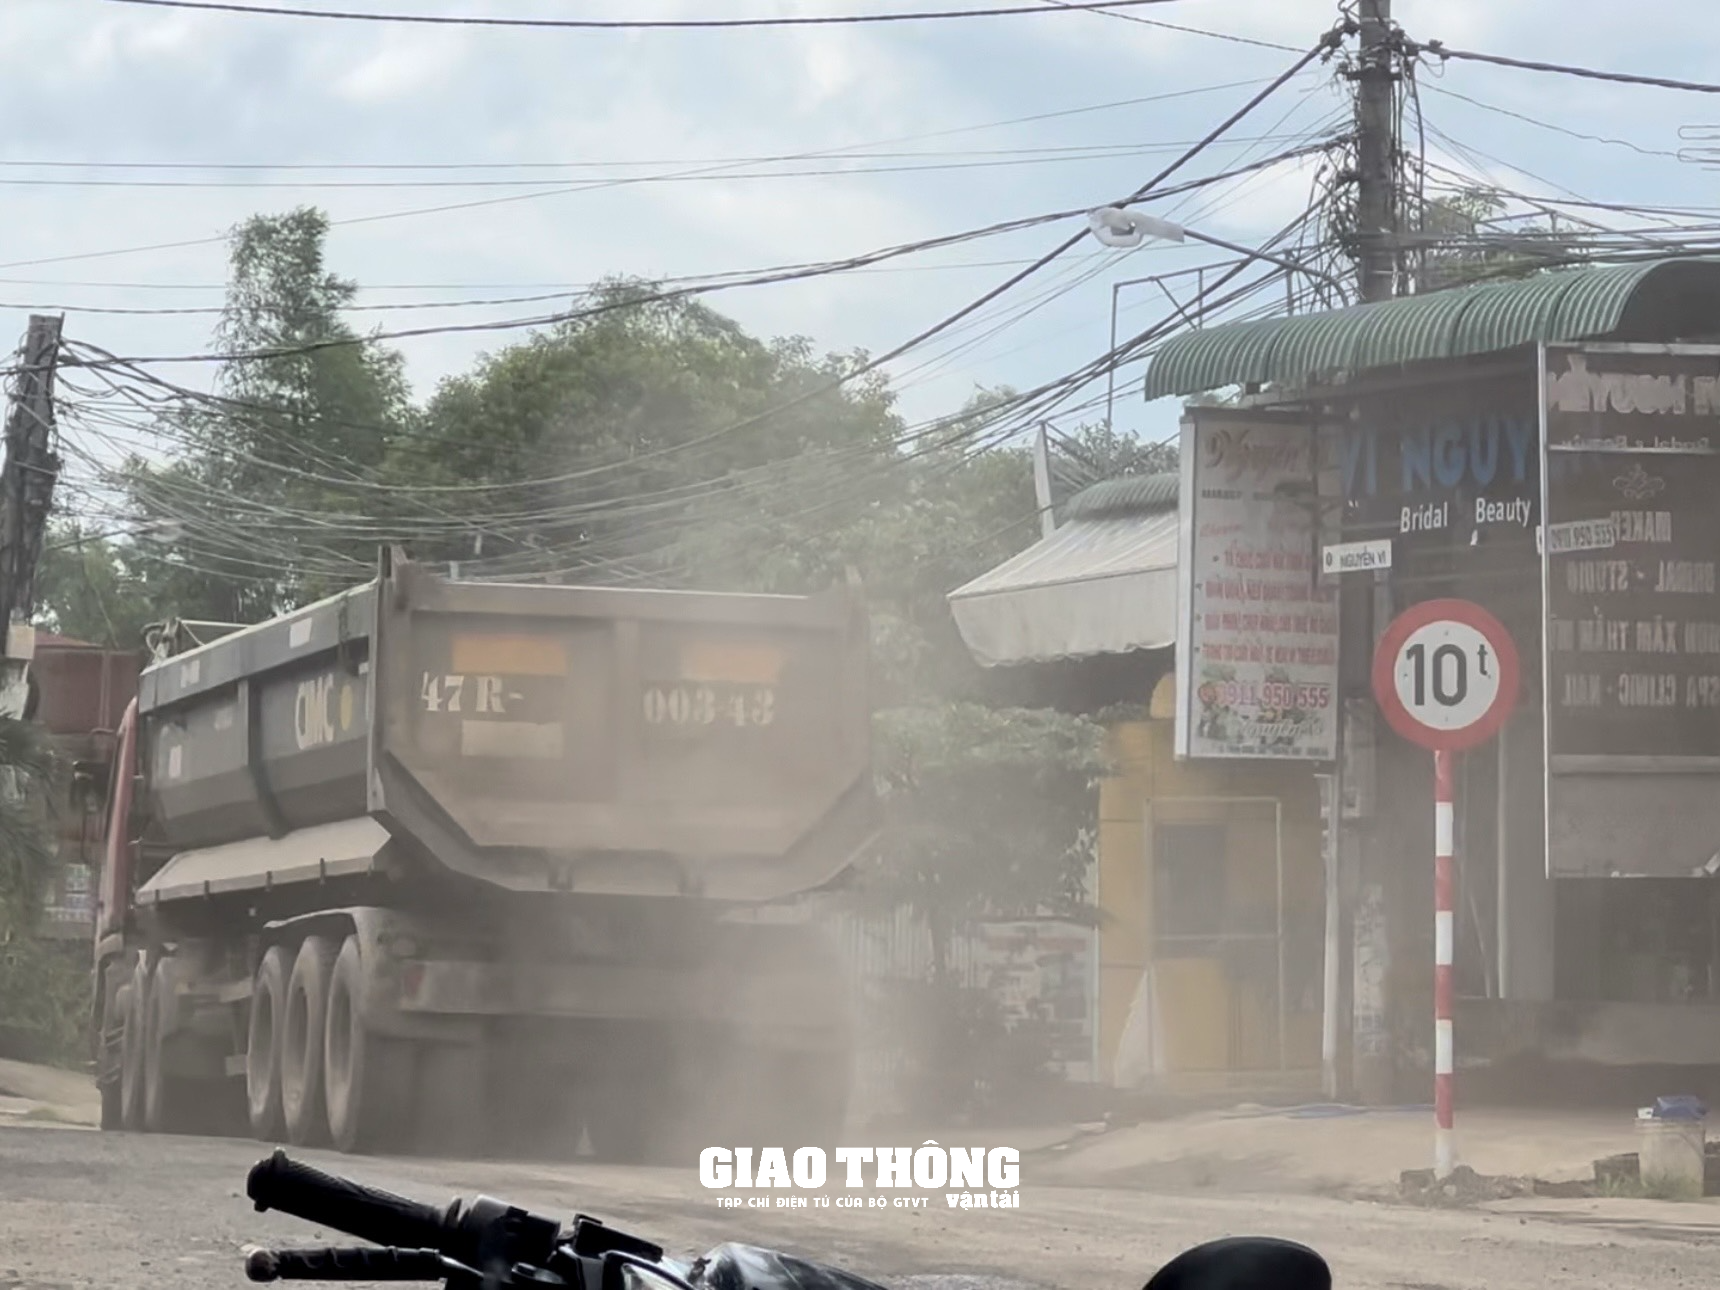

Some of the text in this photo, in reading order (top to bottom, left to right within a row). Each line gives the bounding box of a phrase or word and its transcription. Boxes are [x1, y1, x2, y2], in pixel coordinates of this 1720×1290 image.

[1400, 497, 1531, 533] Bridal Beauty
[1297, 686, 1329, 711] 555
